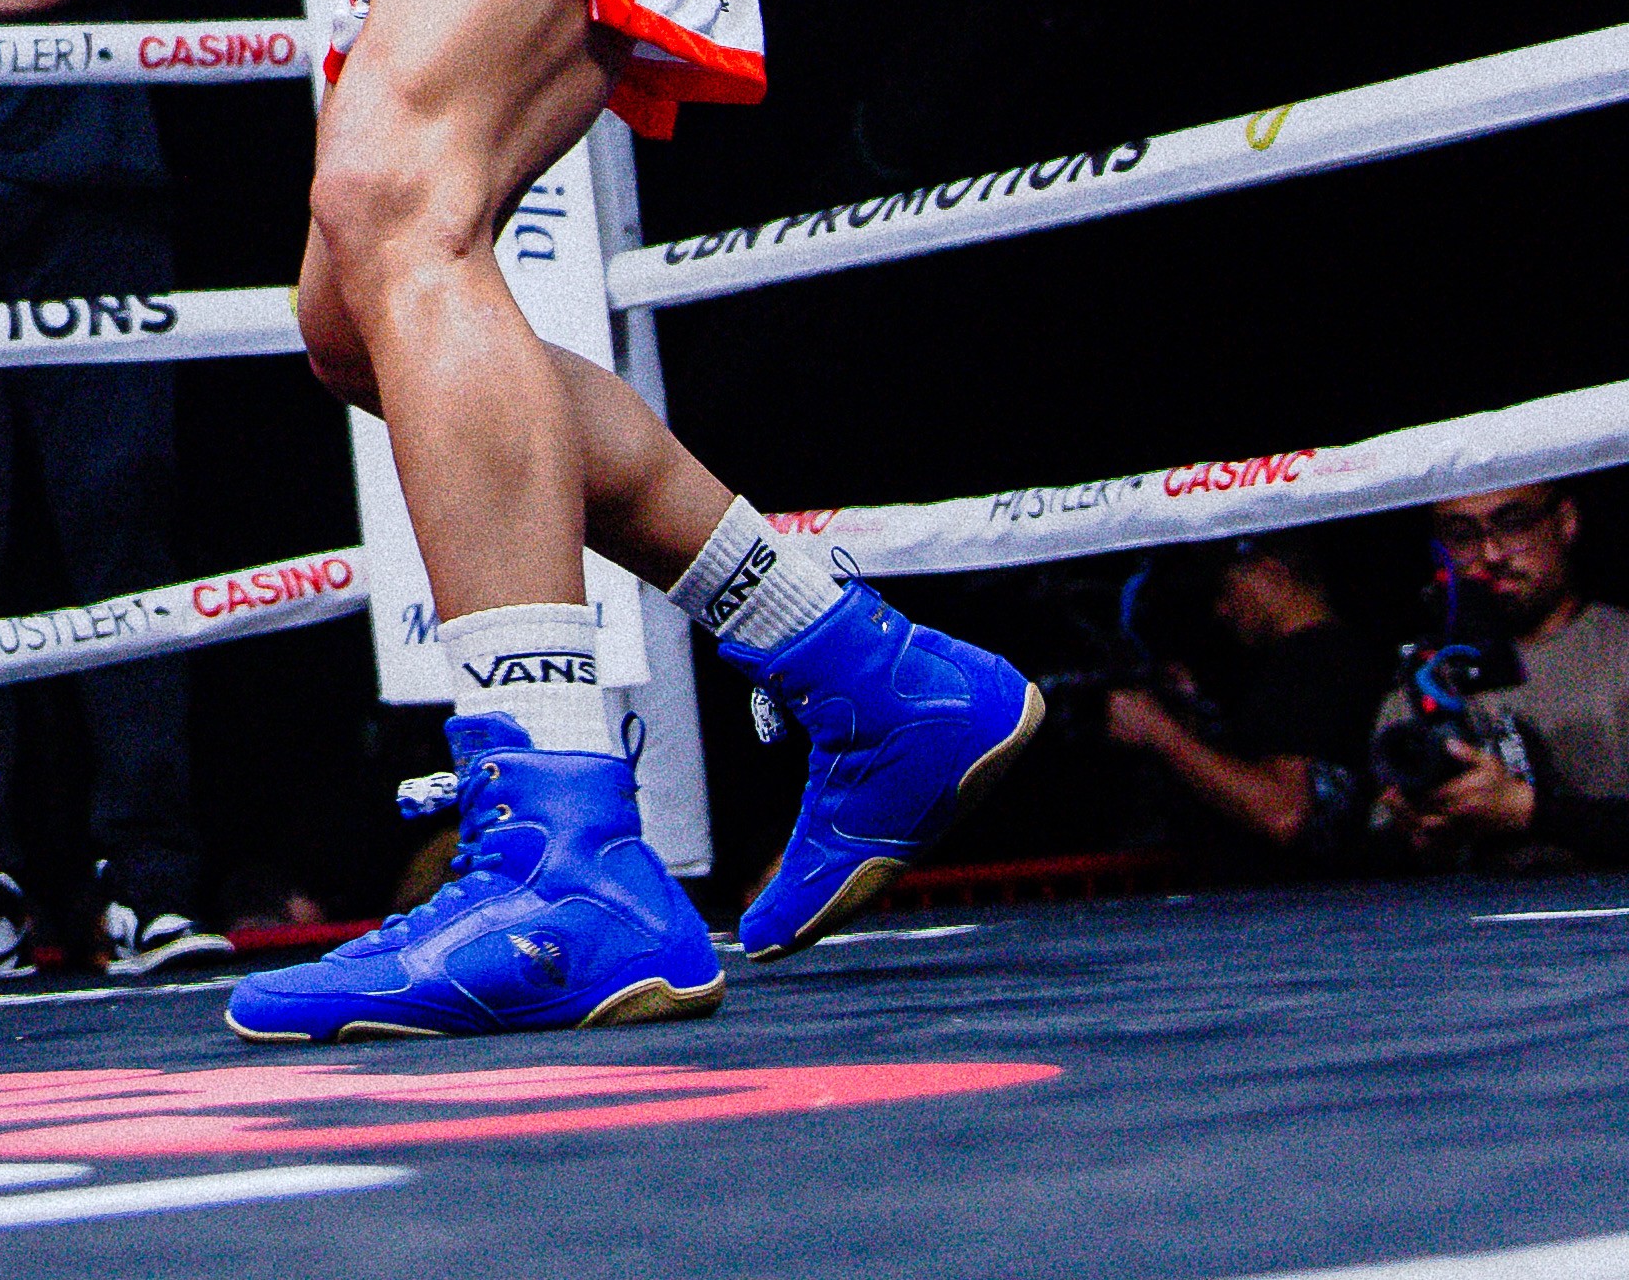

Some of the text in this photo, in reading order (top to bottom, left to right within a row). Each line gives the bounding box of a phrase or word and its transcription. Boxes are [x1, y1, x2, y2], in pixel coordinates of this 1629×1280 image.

[139, 33, 295, 69] CASINO
[193, 558, 353, 617] CASINO
[698, 536, 777, 628] VANS
[462, 651, 598, 689] VANS
